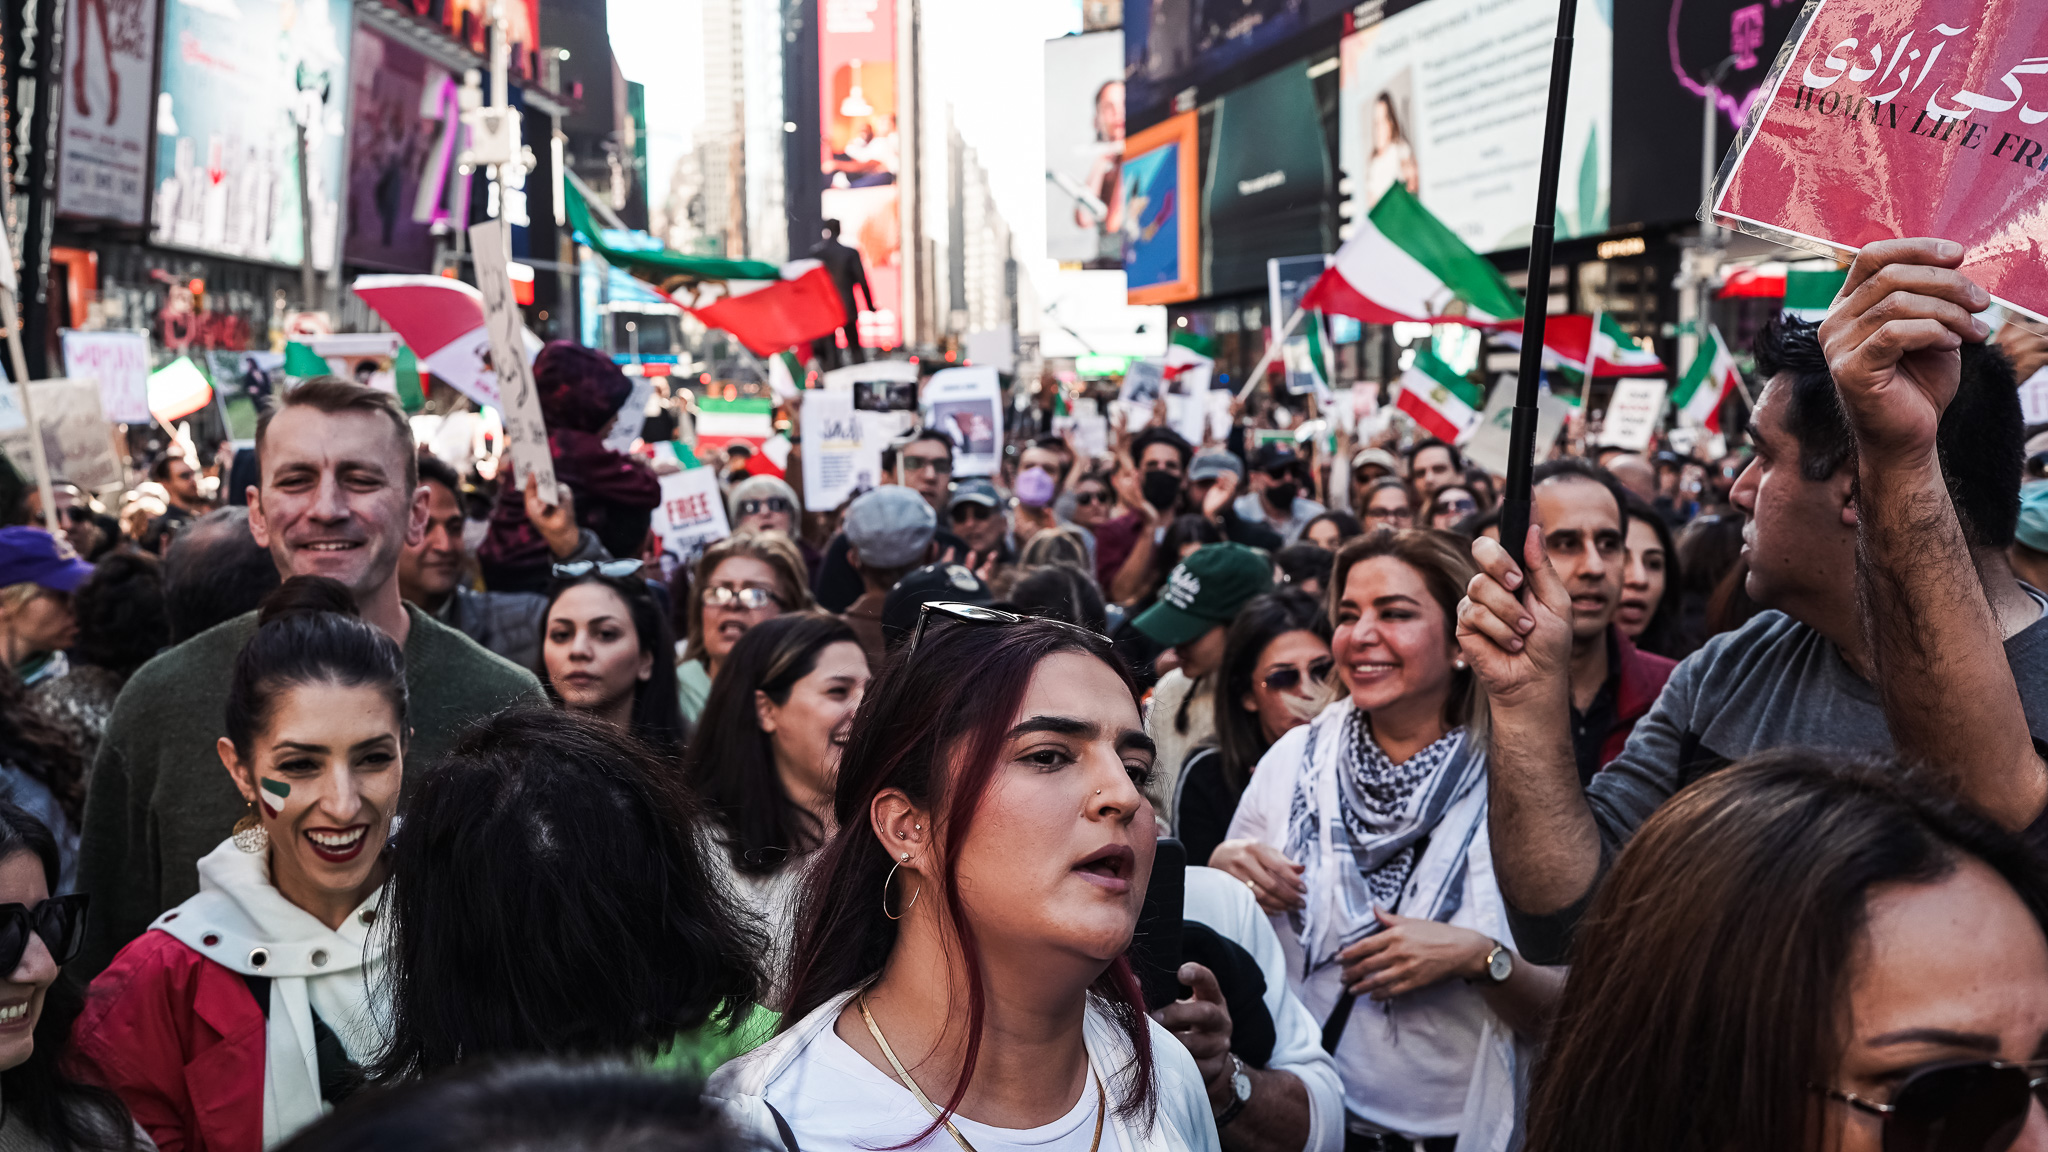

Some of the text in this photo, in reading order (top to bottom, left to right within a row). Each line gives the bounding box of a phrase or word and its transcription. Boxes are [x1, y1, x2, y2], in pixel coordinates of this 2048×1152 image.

[1802, 23, 1970, 105] آزادی
[1793, 85, 2048, 172] WOMAN LIFE FR
[666, 491, 711, 525] FREE
